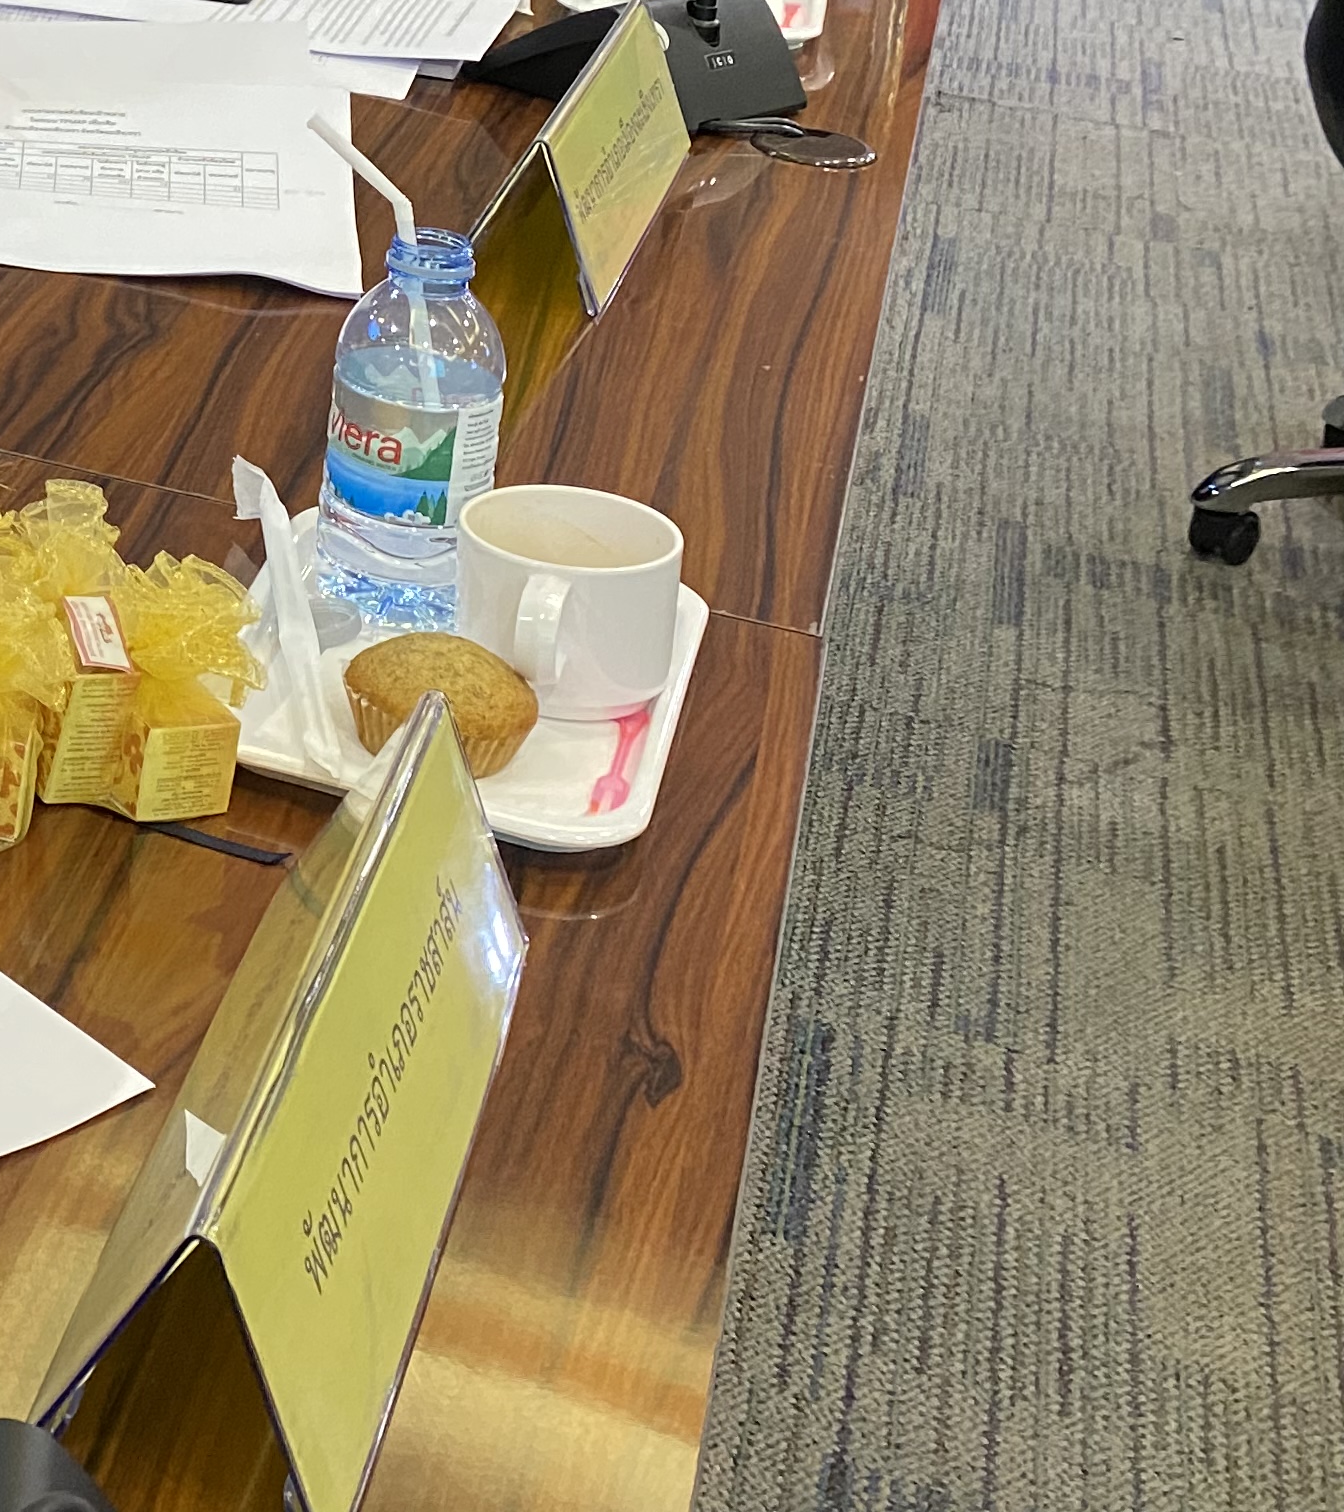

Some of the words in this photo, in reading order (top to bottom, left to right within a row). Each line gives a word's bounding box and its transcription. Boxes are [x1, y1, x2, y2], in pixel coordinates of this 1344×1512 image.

[304, 874, 463, 1293] พัฒนาการอำเภอราชสาส์น
